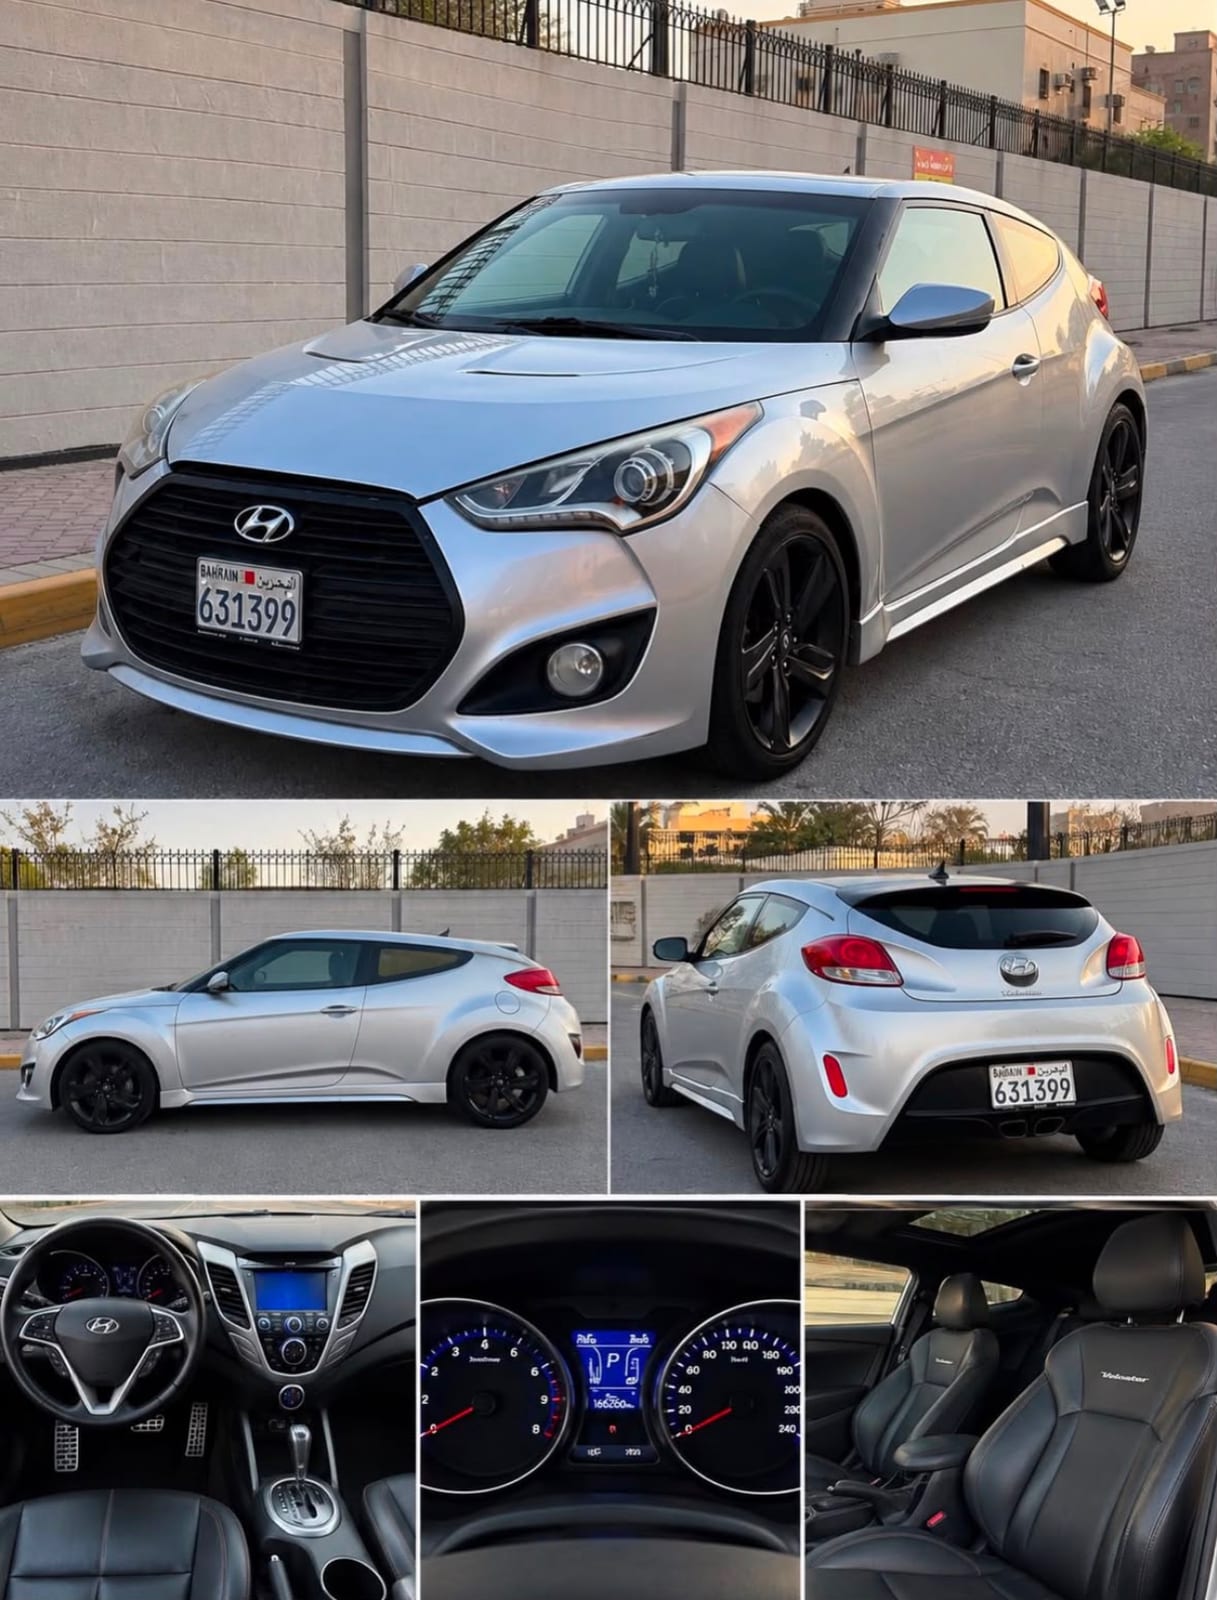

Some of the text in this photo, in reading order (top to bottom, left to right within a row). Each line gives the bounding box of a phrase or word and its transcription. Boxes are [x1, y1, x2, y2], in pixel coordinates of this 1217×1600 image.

[200, 563, 239, 583] BAHRAIN
[199, 586, 297, 638] 631399
[994, 1077, 1071, 1105] 631399
[451, 1346, 460, 1357] 3
[606, 1352, 620, 1368] P
[430, 1366, 439, 1377] 2
[678, 1405, 692, 1415] 20
[532, 1423, 540, 1434] 8
